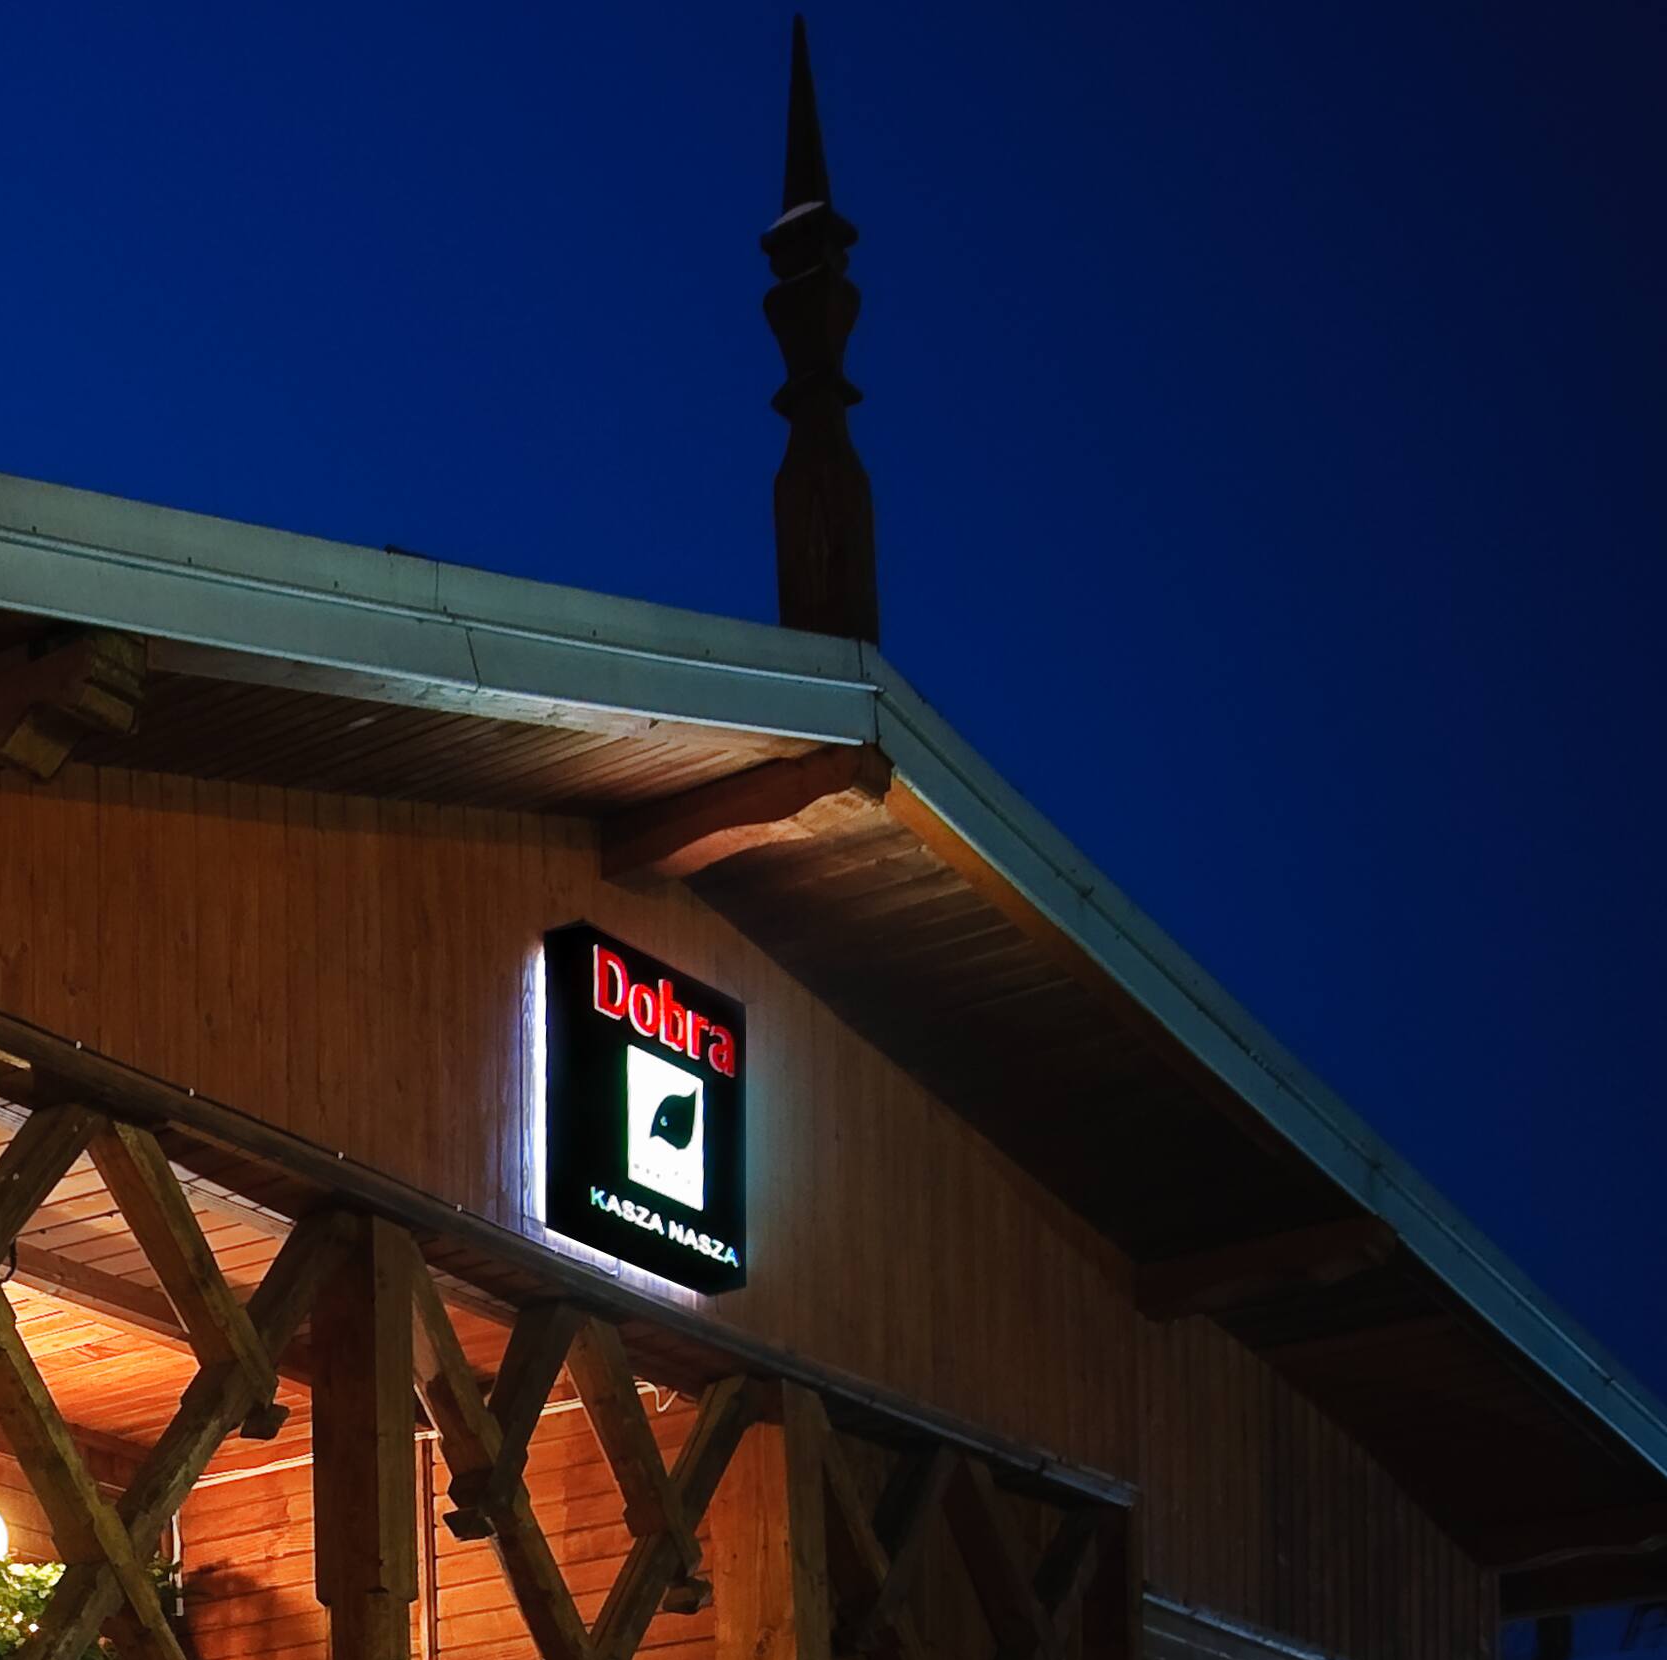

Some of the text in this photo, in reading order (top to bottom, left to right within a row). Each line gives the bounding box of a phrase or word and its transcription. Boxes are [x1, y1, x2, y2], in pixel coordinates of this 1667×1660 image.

[593, 944, 736, 1078] Dobra
[590, 1186, 740, 1268] KASZA NASZA
